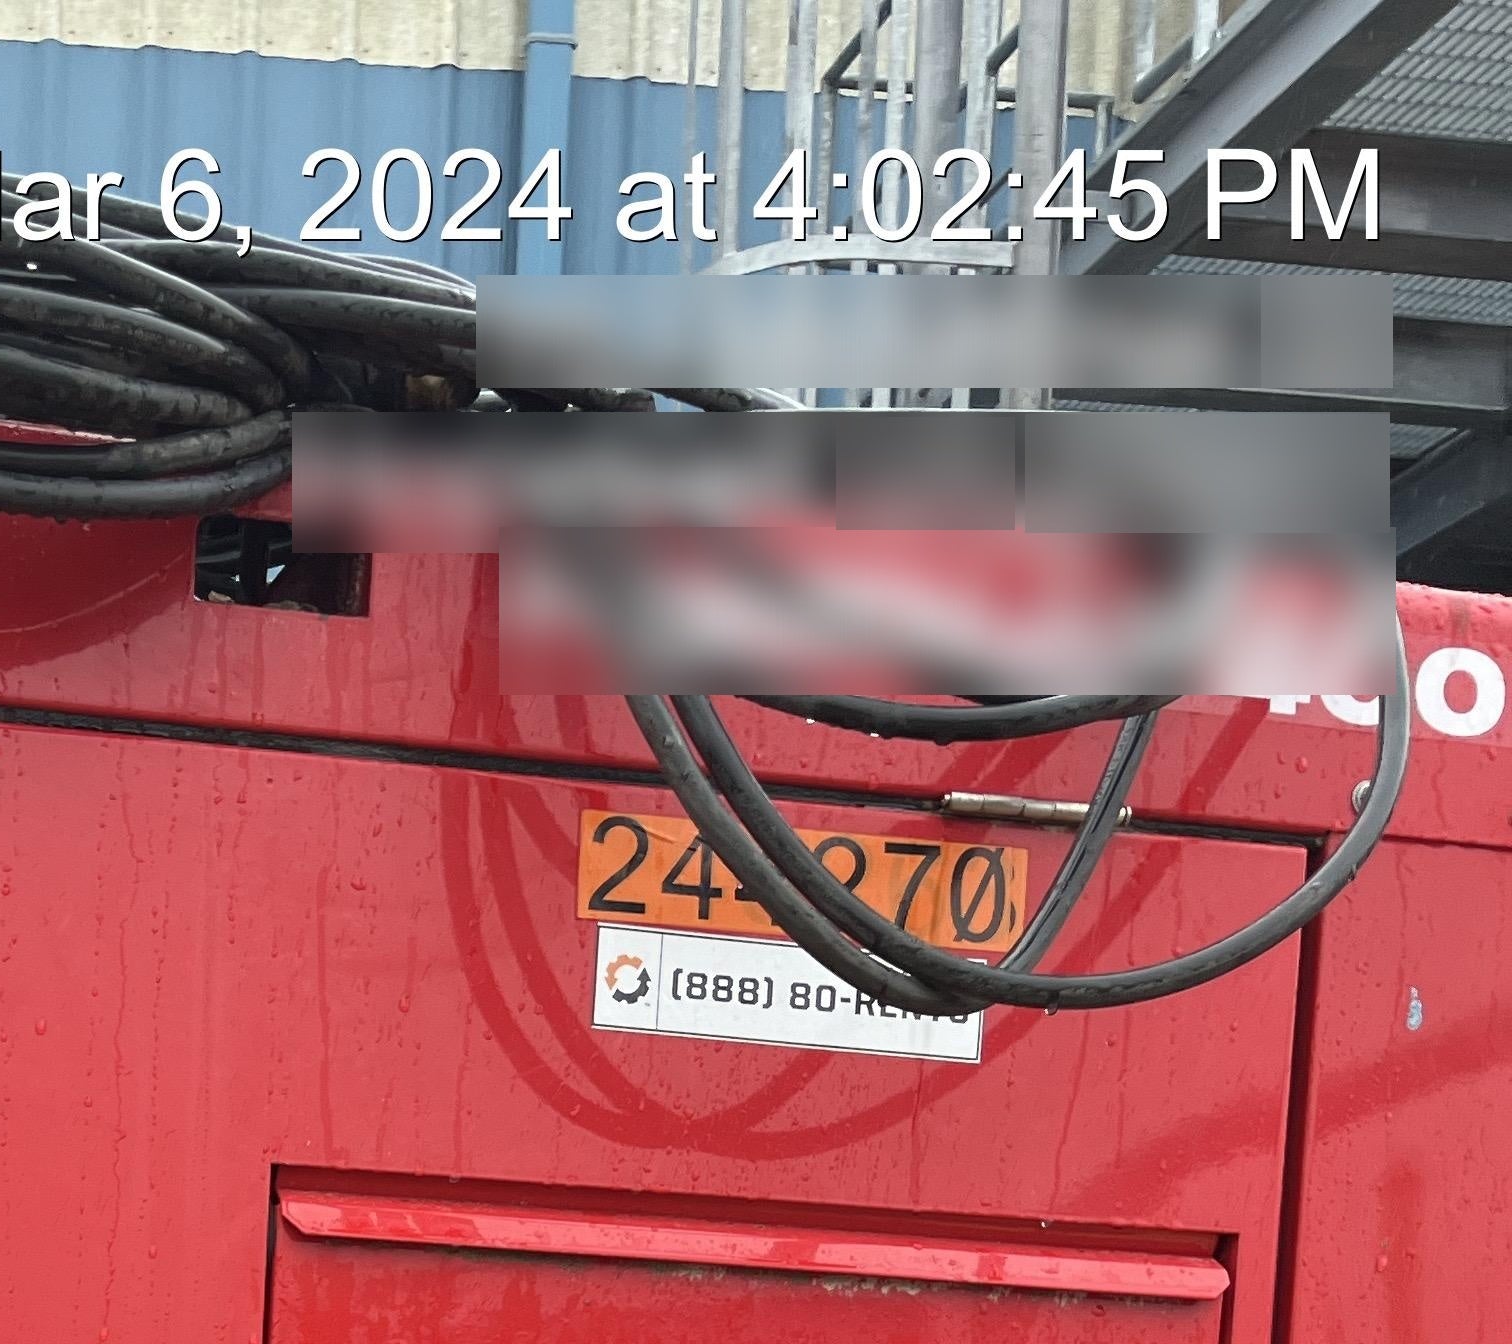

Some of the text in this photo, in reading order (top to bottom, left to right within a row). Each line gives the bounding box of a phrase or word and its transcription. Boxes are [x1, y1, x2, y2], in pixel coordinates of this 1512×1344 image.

[588, 815, 1008, 943] 24270
[671, 967, 969, 1025] (888) 80-R
